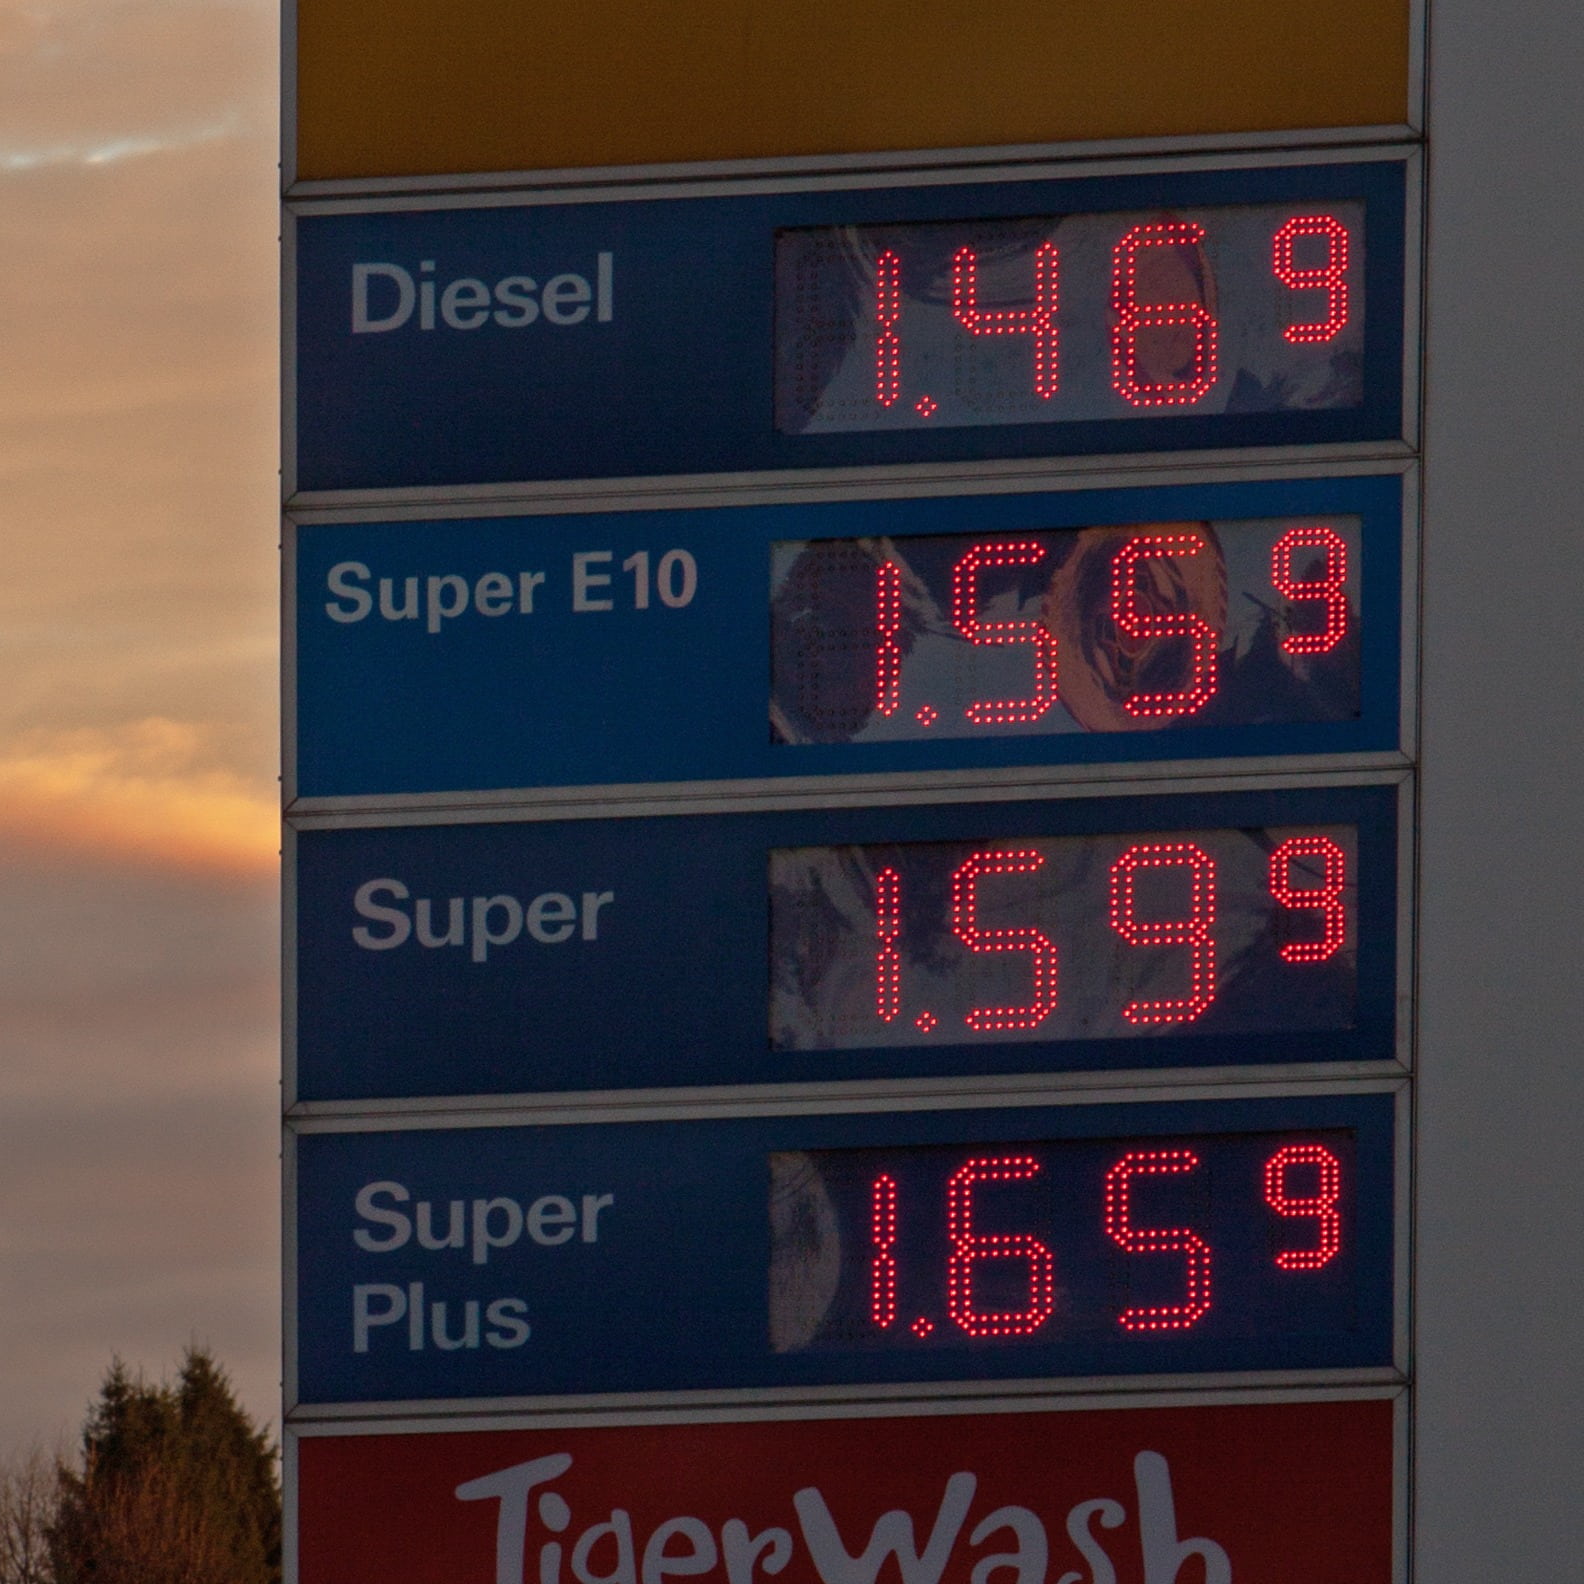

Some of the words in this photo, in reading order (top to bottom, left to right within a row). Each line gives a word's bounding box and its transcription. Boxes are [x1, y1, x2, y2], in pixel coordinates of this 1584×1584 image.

[350, 252, 614, 335] Diesel
[324, 561, 546, 632] Super
[572, 549, 699, 613] E10
[350, 877, 614, 970] Super
[352, 1181, 614, 1264] Super
[352, 1282, 532, 1354] Plus
